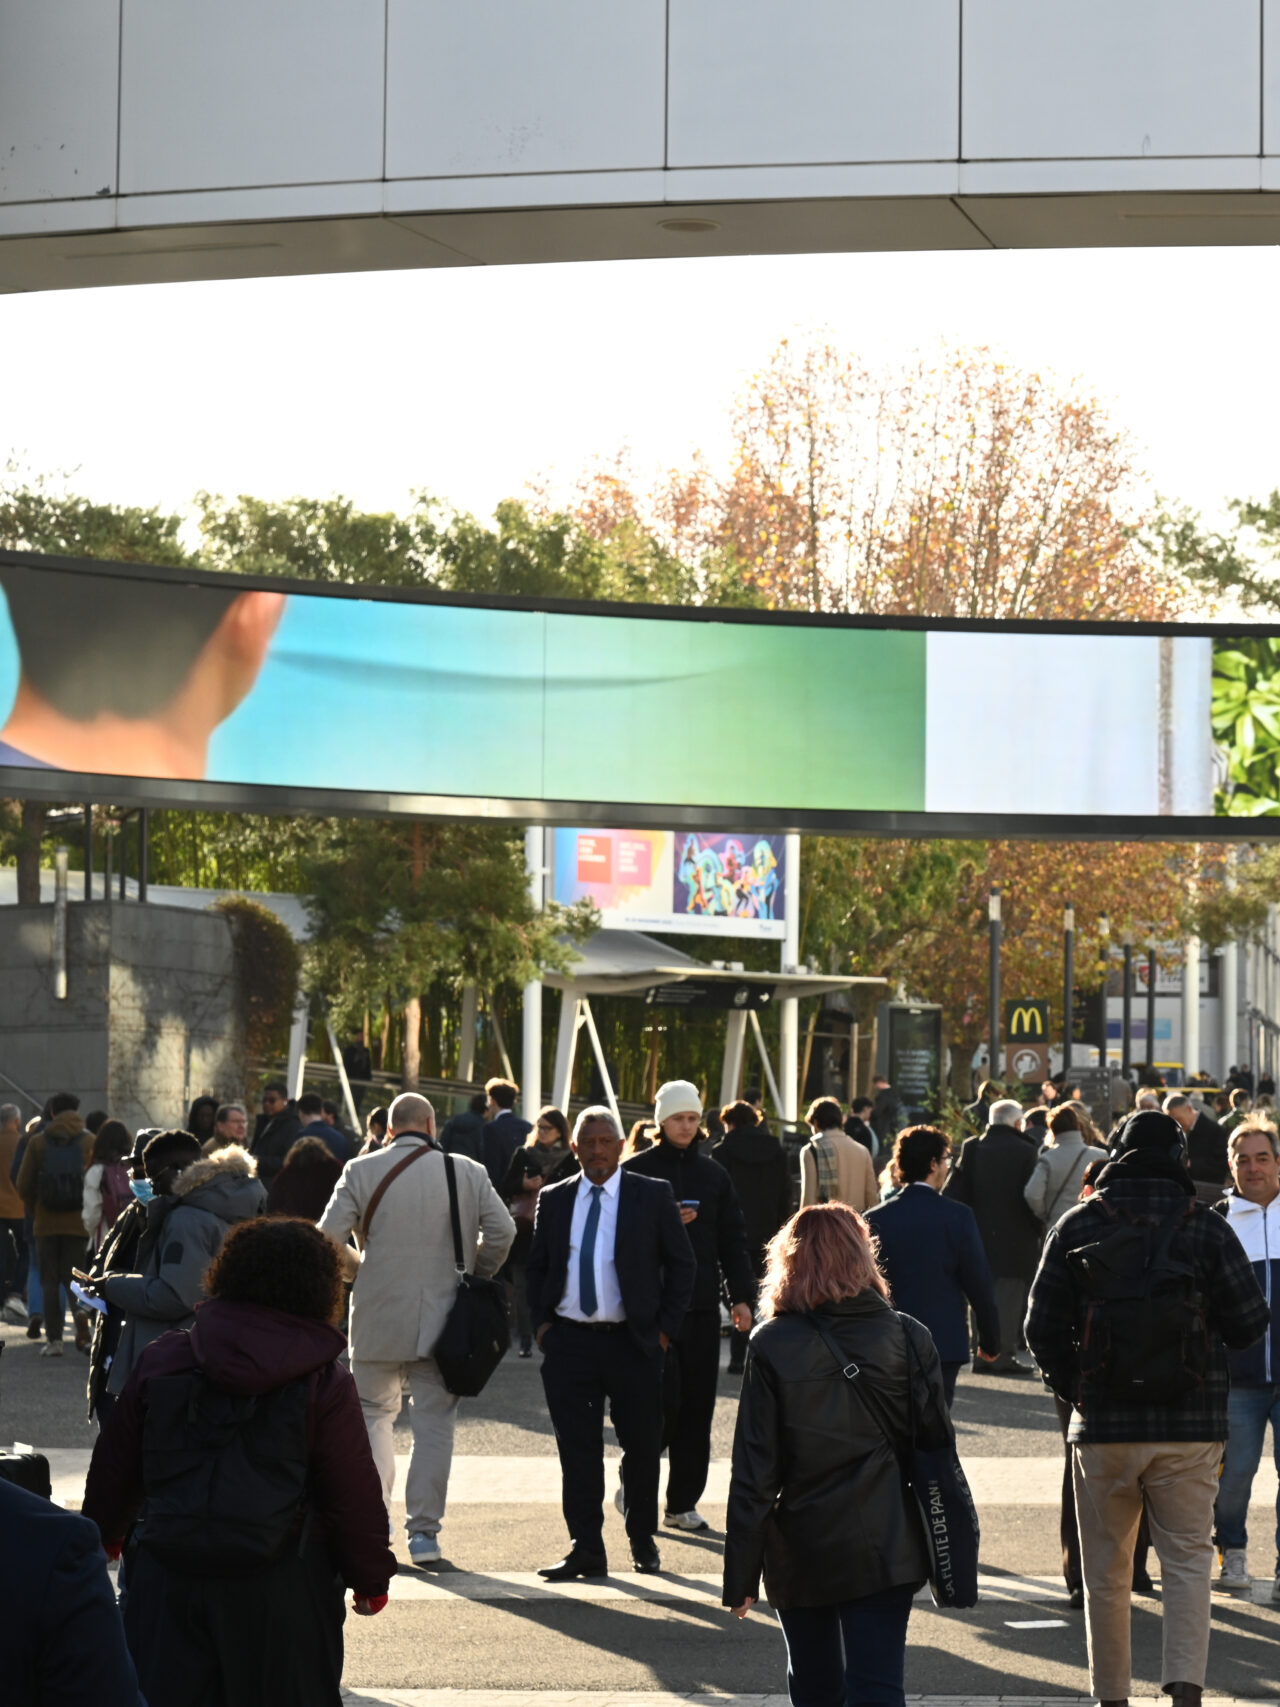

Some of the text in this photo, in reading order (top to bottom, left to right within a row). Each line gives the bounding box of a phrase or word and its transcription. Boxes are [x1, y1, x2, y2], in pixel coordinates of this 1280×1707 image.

[928, 1486, 945, 1514] PAN
[932, 1516, 948, 1534] DE
[935, 1536, 952, 1579] FLUTE
